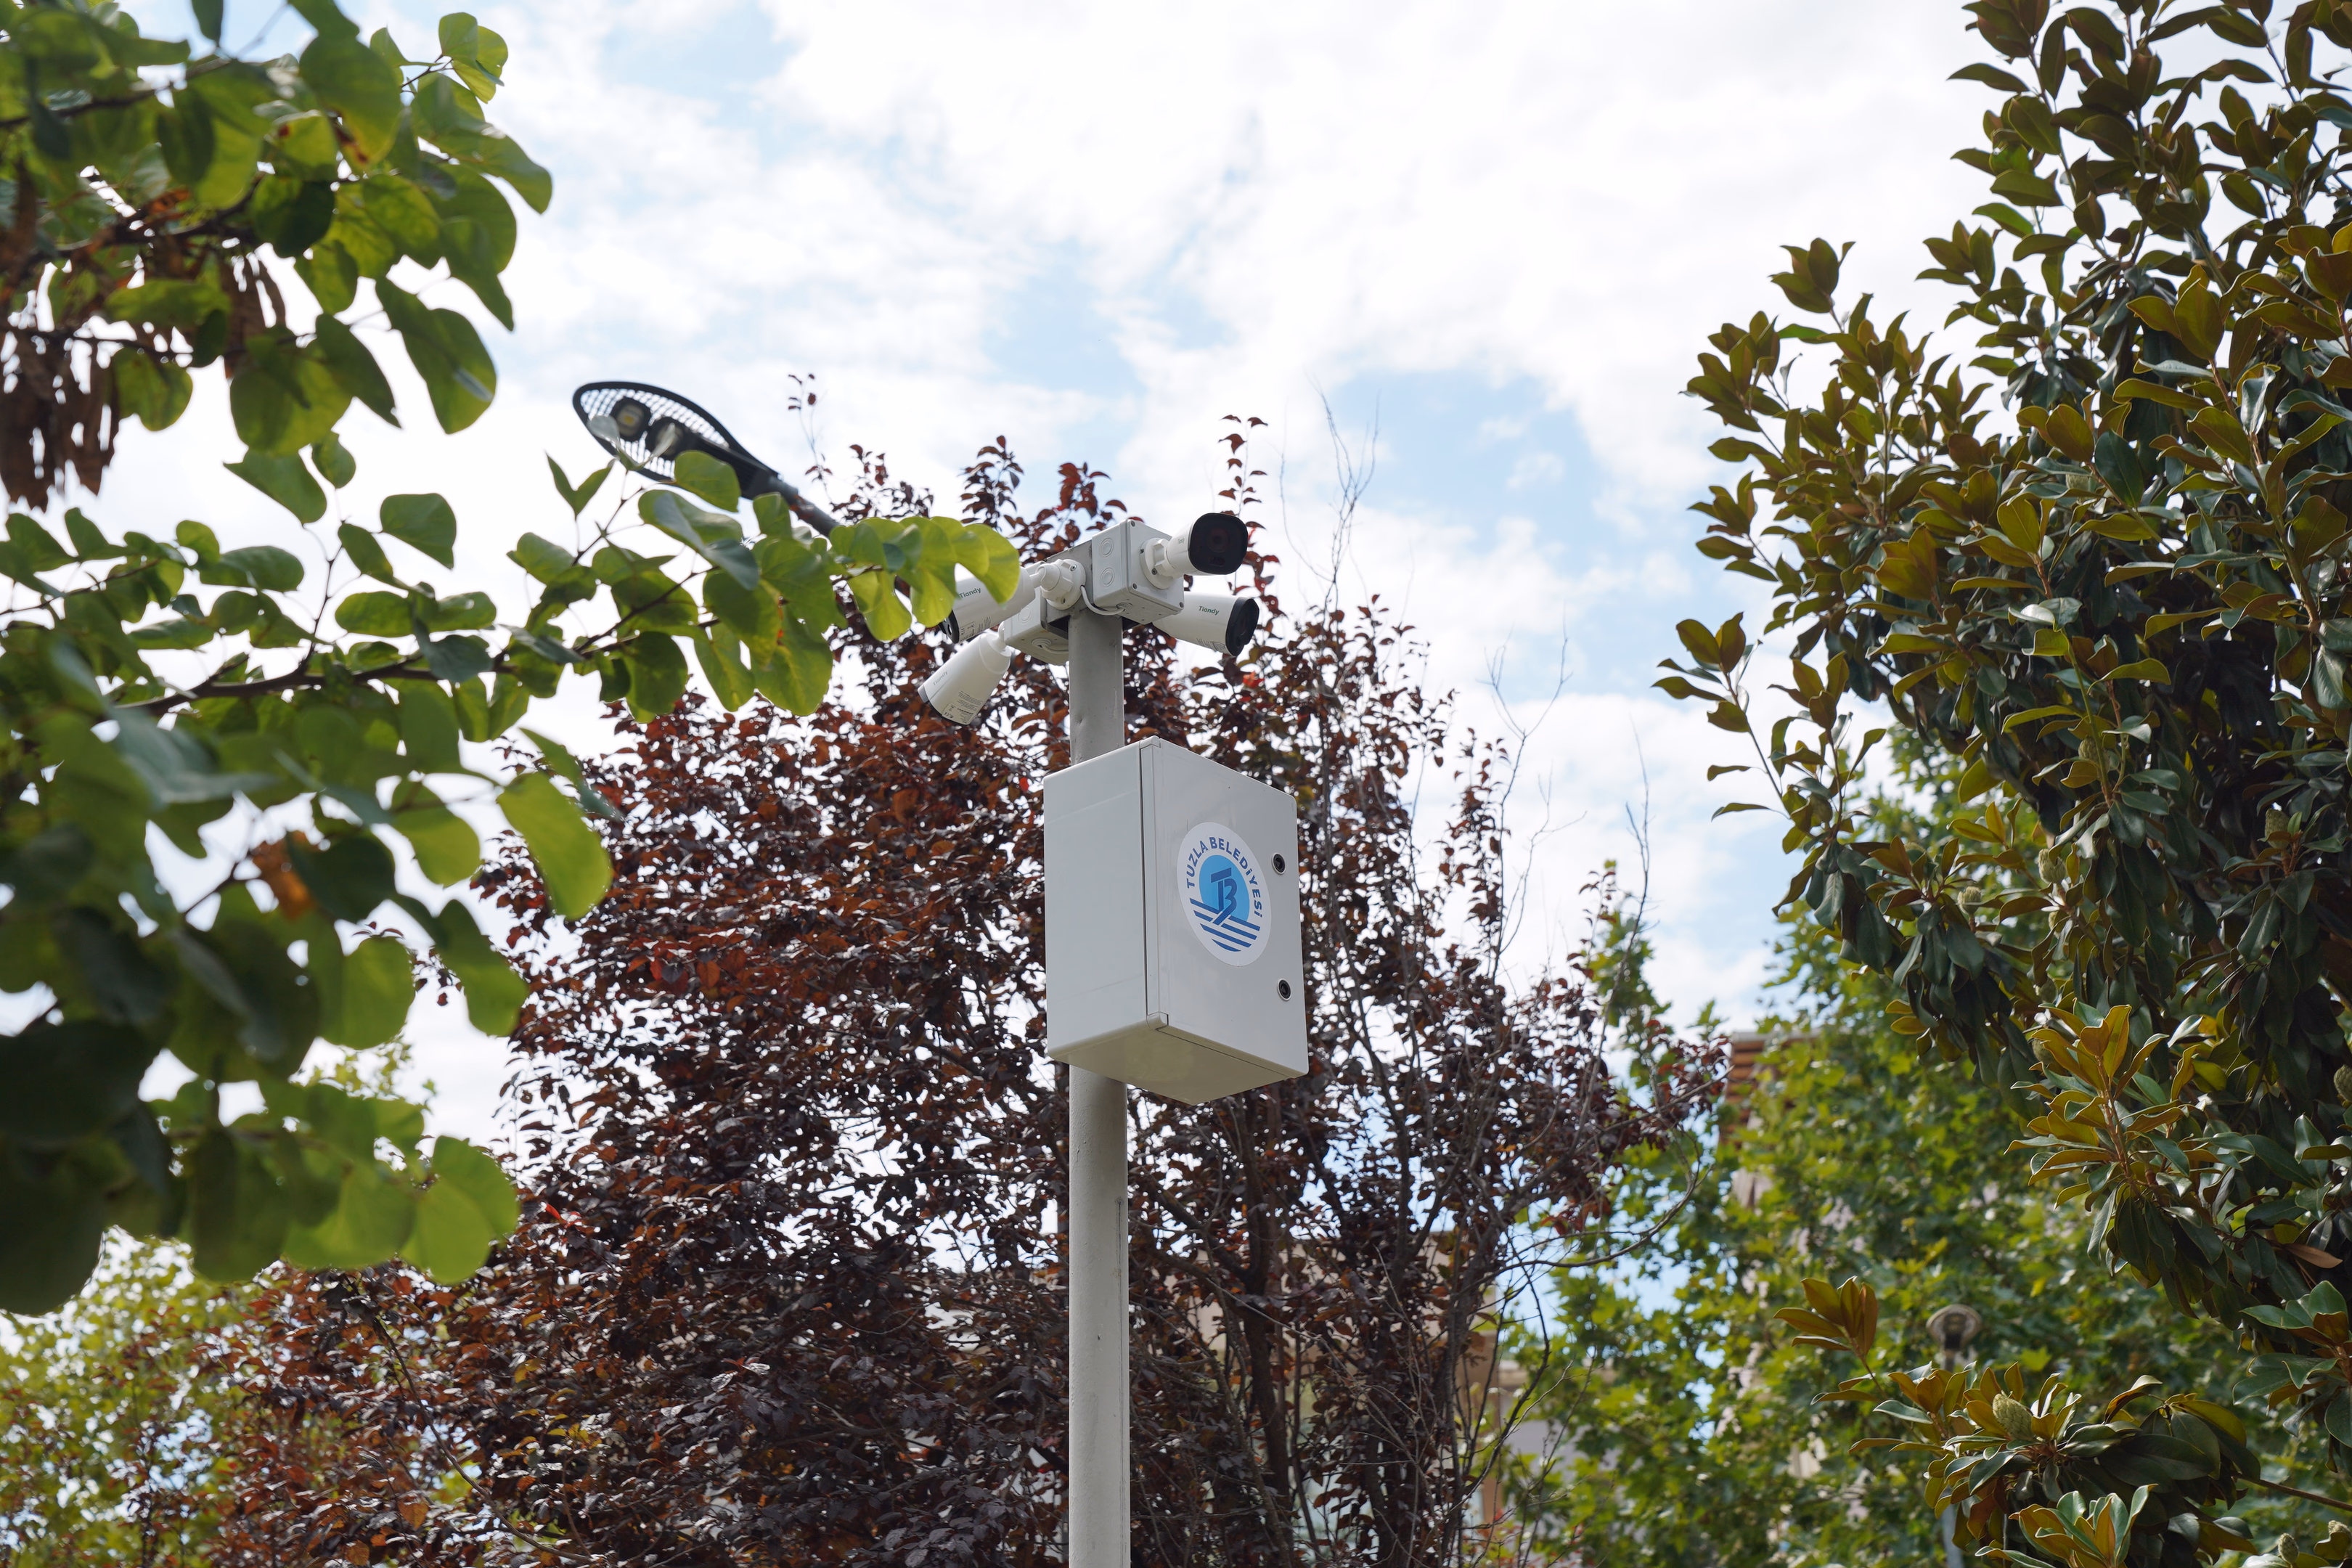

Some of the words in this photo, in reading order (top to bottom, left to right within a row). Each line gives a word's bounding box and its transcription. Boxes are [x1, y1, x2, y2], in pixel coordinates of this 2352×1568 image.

[959, 587, 981, 598] Tiandy
[1199, 605, 1220, 616] Tiandy
[933, 670, 948, 686] Tiandy
[1186, 840, 1209, 889] TUZLA
